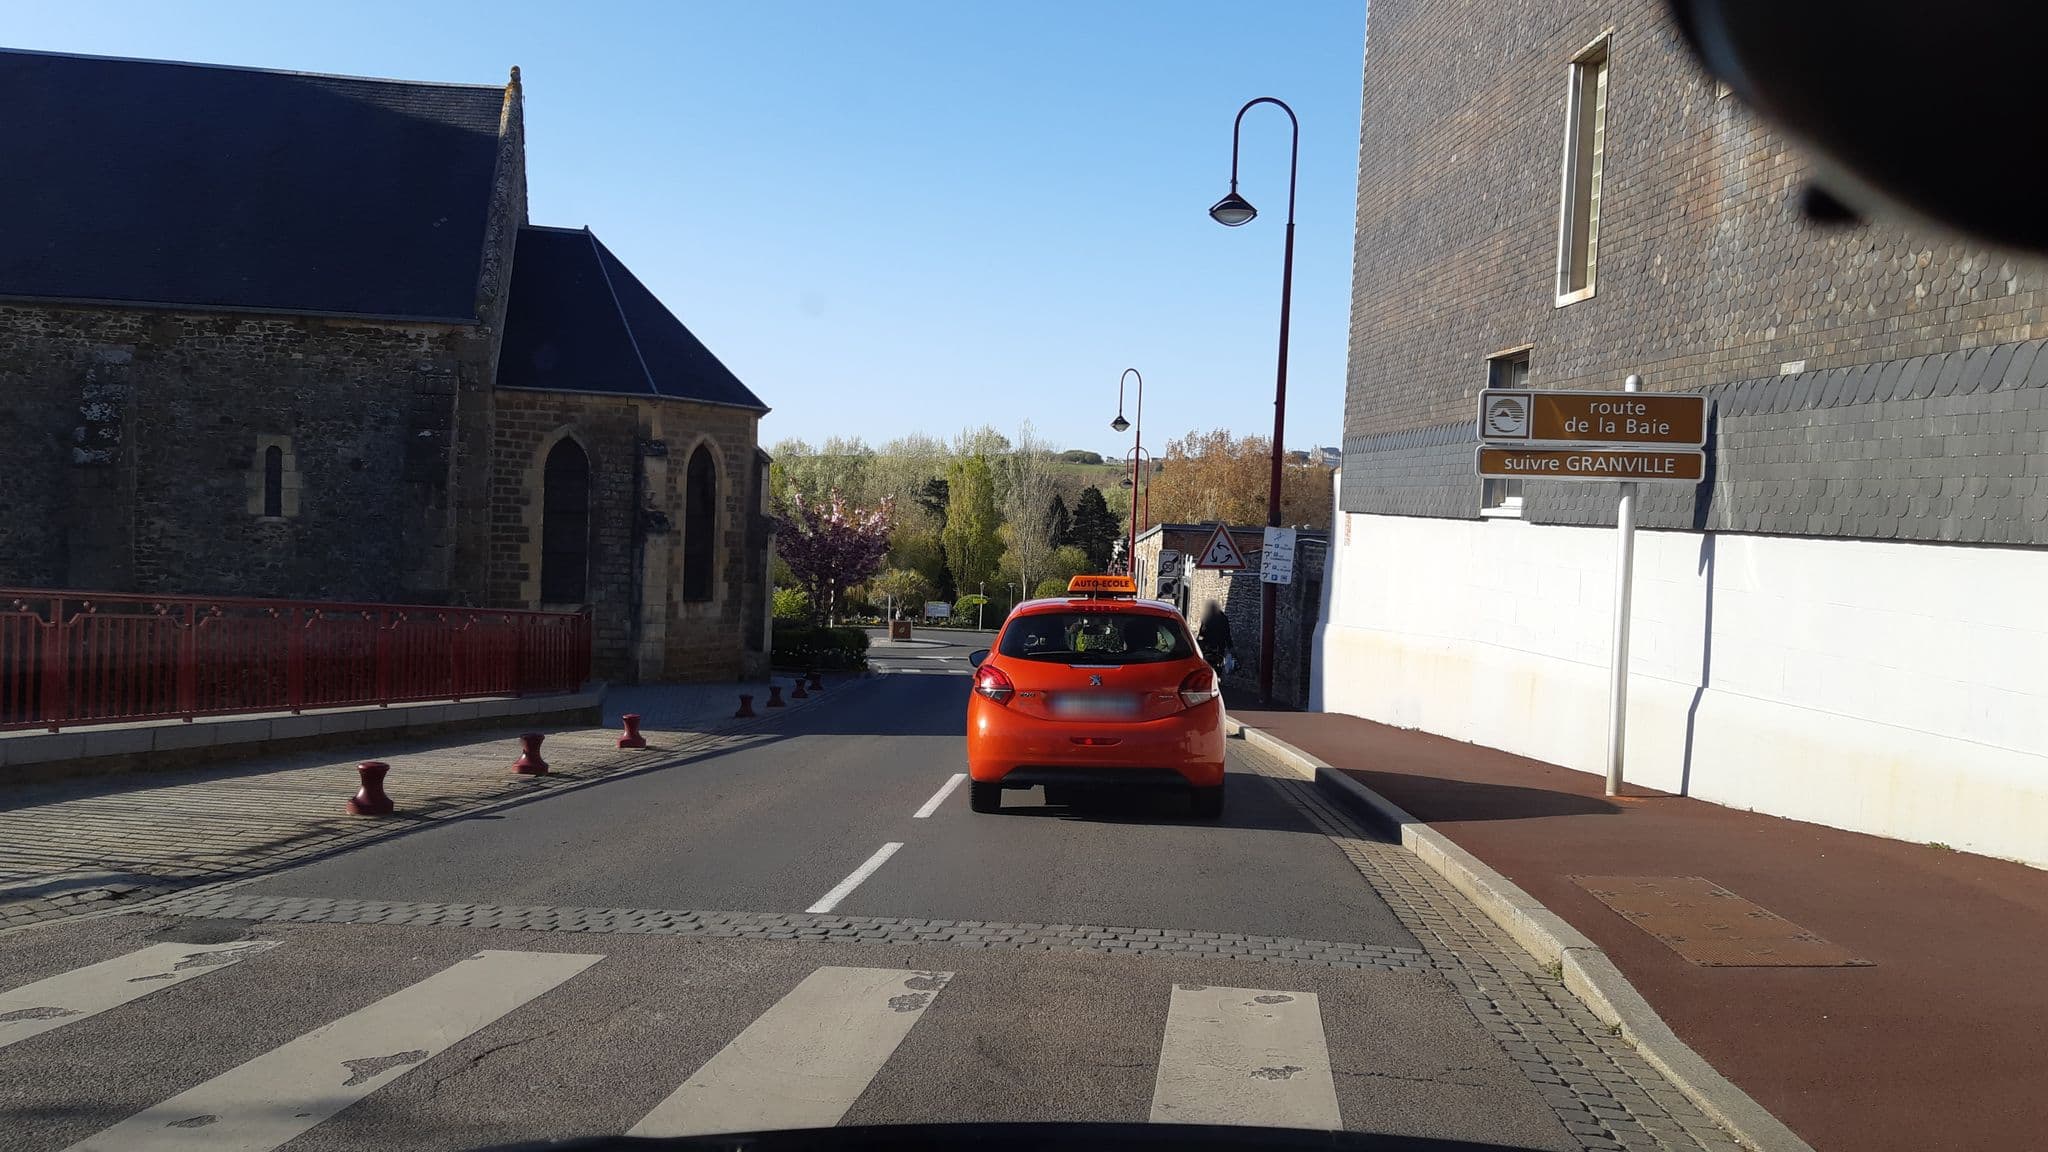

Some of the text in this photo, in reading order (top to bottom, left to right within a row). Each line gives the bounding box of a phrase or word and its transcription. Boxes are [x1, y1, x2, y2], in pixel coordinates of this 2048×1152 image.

[1589, 400, 1647, 415] route
[1564, 416, 1671, 435] de la Baie
[1503, 456, 1676, 474] suivre GRANVILLE
